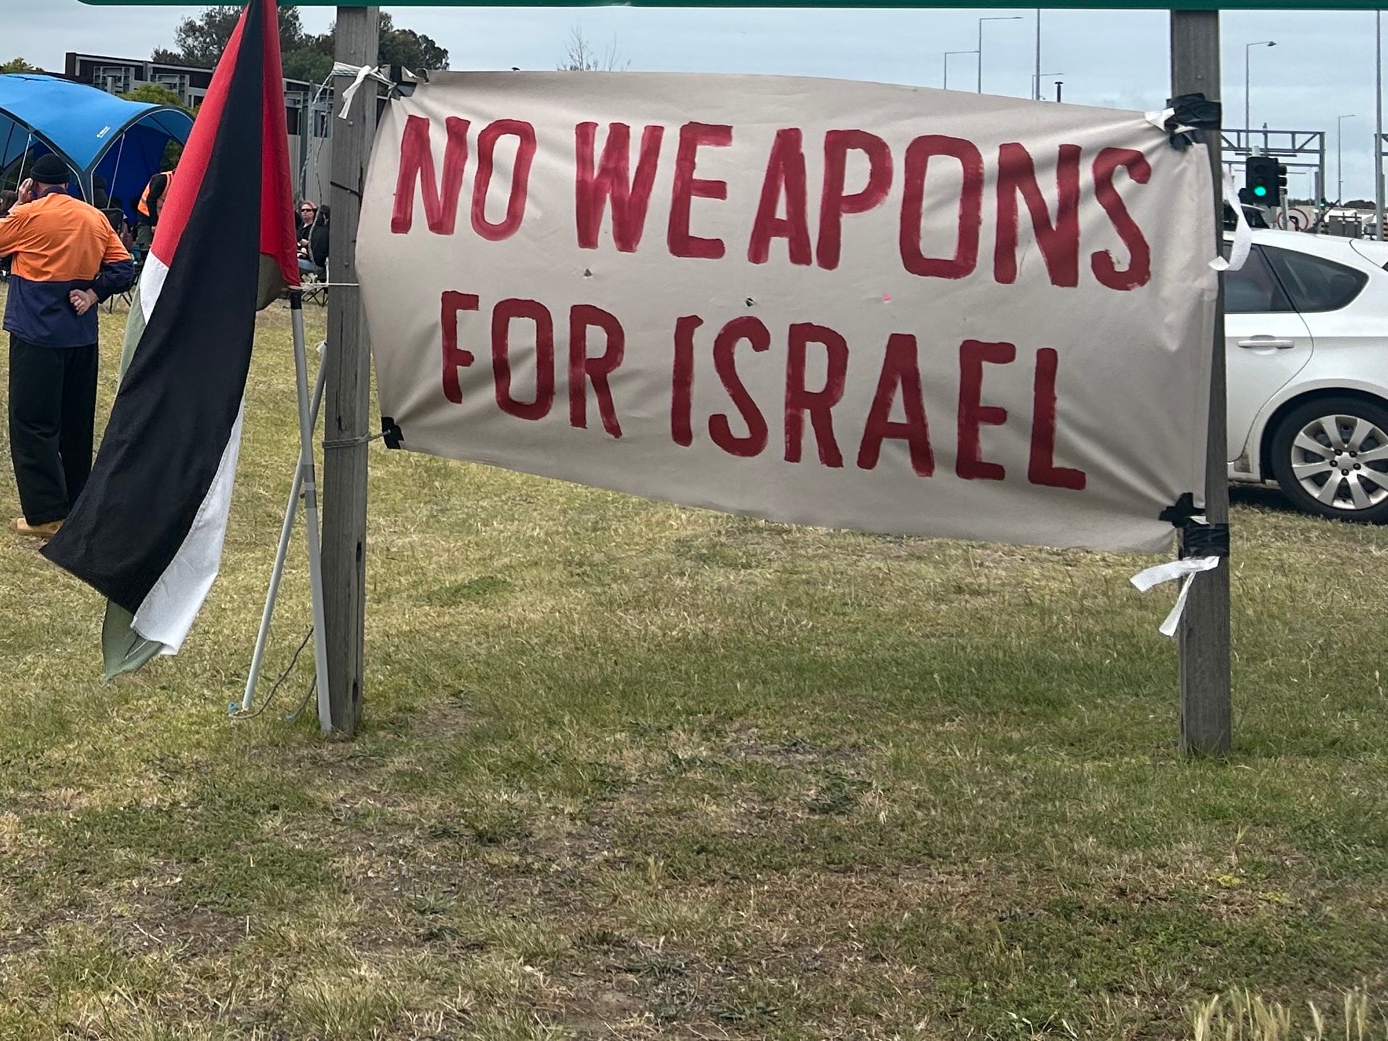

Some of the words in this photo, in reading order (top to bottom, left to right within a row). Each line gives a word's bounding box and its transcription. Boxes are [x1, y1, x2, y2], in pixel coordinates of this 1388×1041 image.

[390, 114, 537, 242] NO
[575, 121, 1152, 291] WEAPONS
[440, 290, 625, 439] FOR
[670, 314, 1087, 490] ISRAEL
